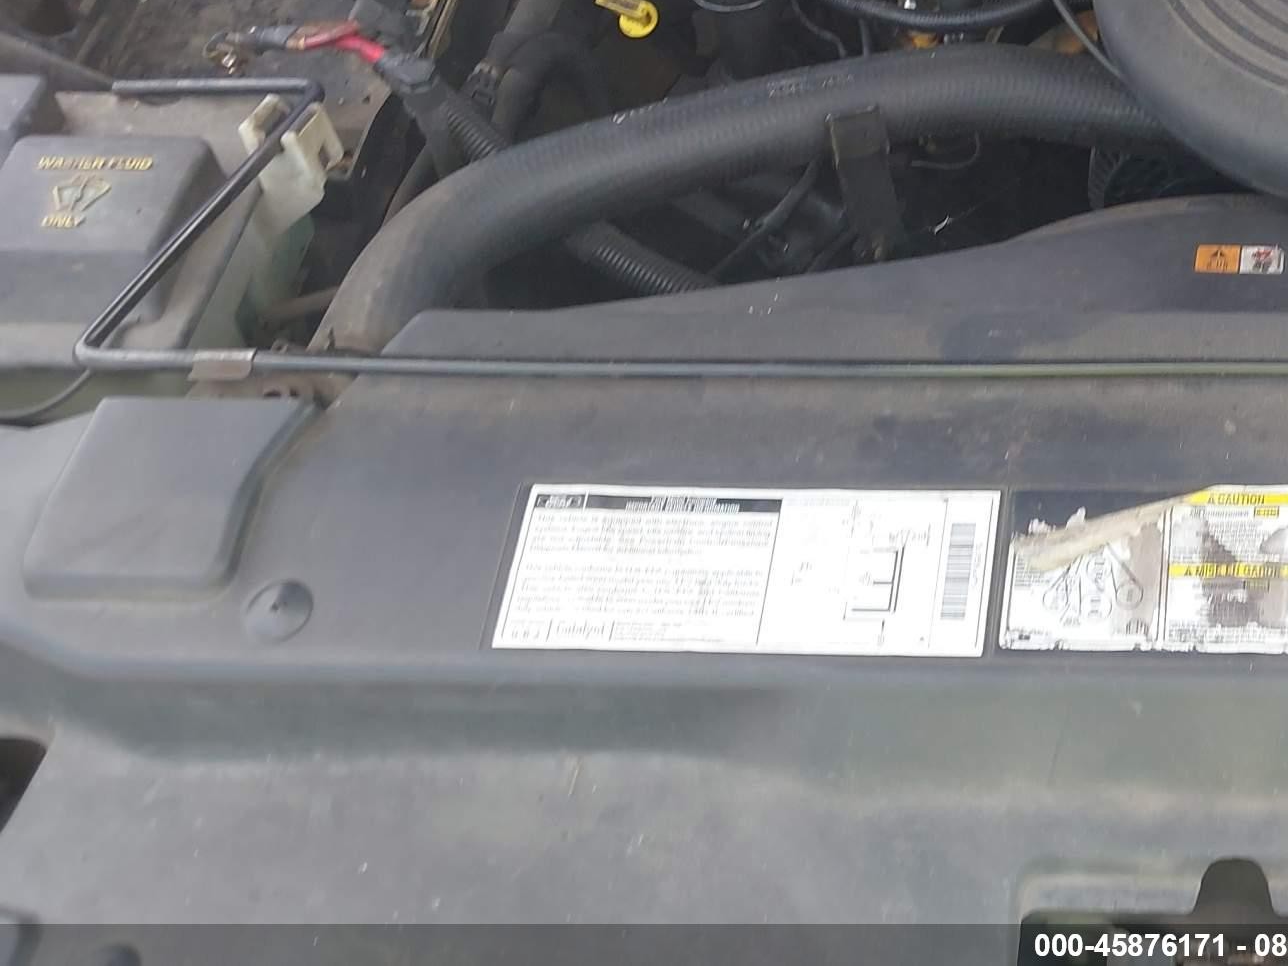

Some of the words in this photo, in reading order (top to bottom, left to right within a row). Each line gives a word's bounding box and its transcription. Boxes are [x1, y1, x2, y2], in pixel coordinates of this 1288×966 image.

[37, 156, 105, 170] WASHER
[107, 156, 154, 170] FLUID
[41, 215, 86, 228] ONLY
[1217, 493, 1265, 506] CAUTION
